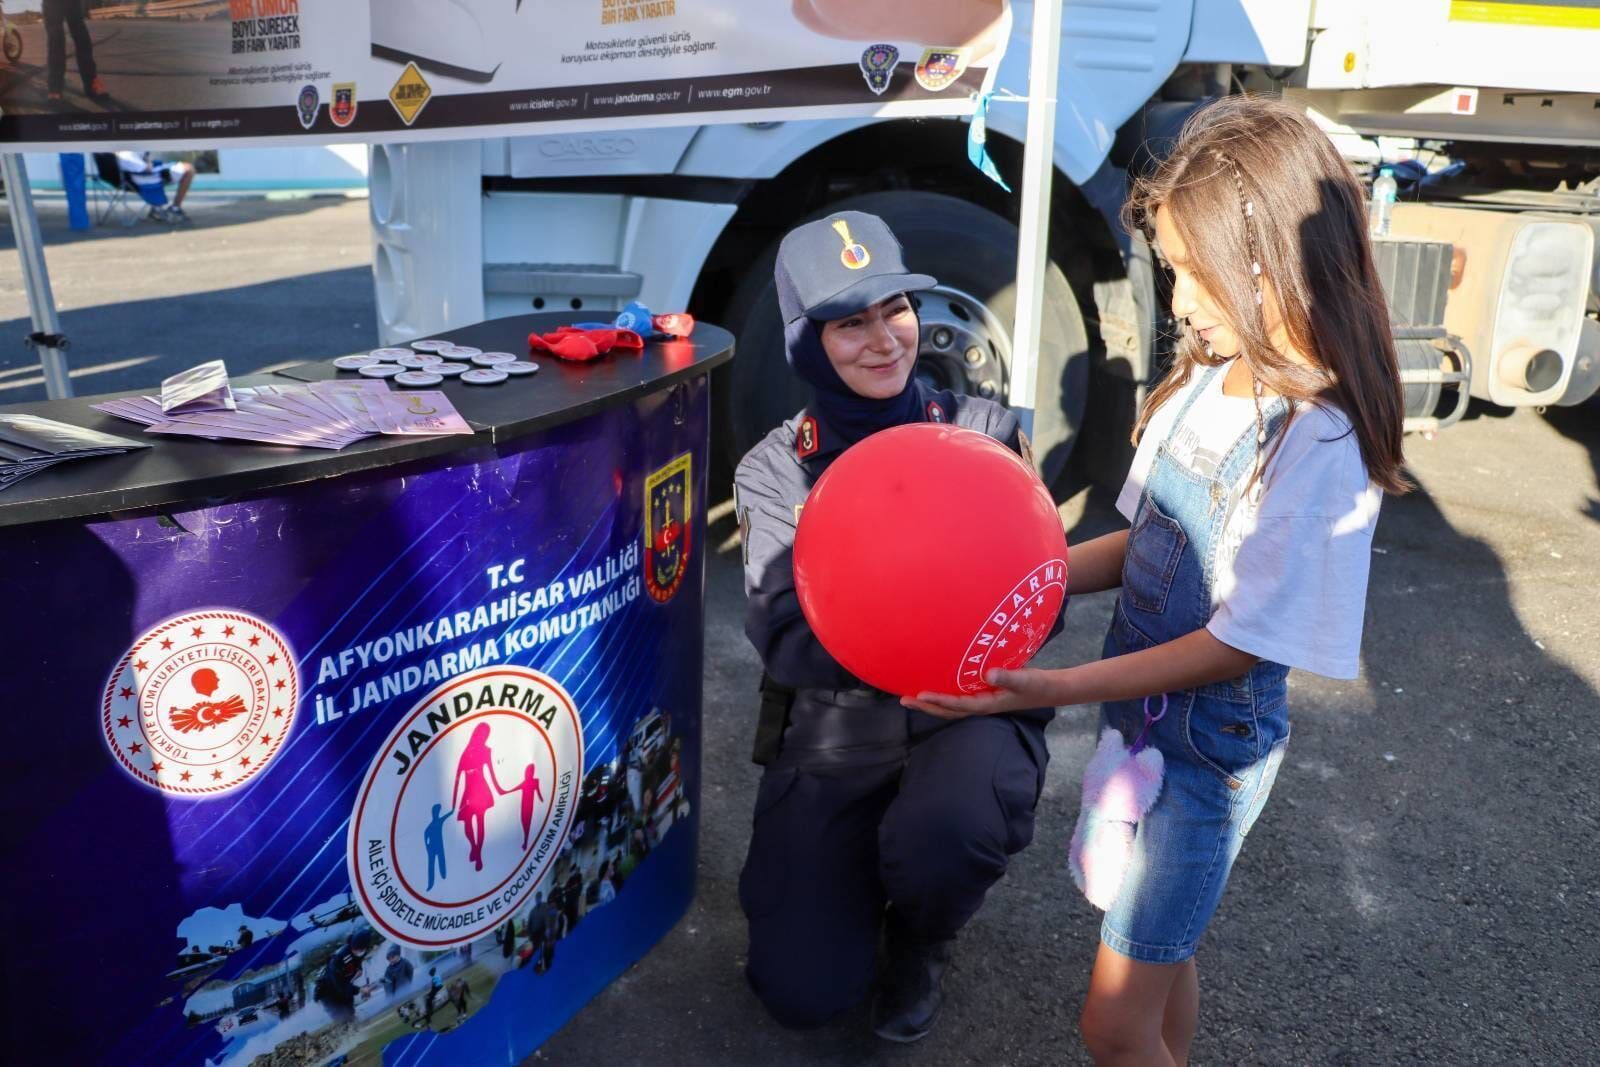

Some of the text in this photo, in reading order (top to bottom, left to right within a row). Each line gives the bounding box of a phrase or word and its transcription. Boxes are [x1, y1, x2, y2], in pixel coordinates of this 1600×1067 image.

[561, 52, 599, 64] koruyucu
[600, 49, 636, 62] ekipman
[638, 45, 681, 58] desteğiyle
[585, 31, 691, 50] Motosikletle güvenli sürüş
[593, 91, 681, 106] www.jandarma.gov.tr
[698, 84, 772, 99] www.egm.gov.tr
[539, 137, 637, 156] CARGO
[487, 558, 525, 590] T.C
[317, 541, 638, 685] AFYONKARAHİSAR VALİLİĞİ
[963, 564, 1062, 677] JANDARMA
[315, 575, 641, 726] İL JANDARMA KOMUTANLIĞI
[143, 646, 265, 760] TÜRKİYE CUMHURİYETİ İÇİŞLERİ BAKANLIĞI
[388, 683, 558, 776] JANDARMA
[368, 770, 573, 931] AİLE İÇİ ŞİDDETLE MÜCADELE VE ÇOCUK KISIM AMİRLİĞİ
